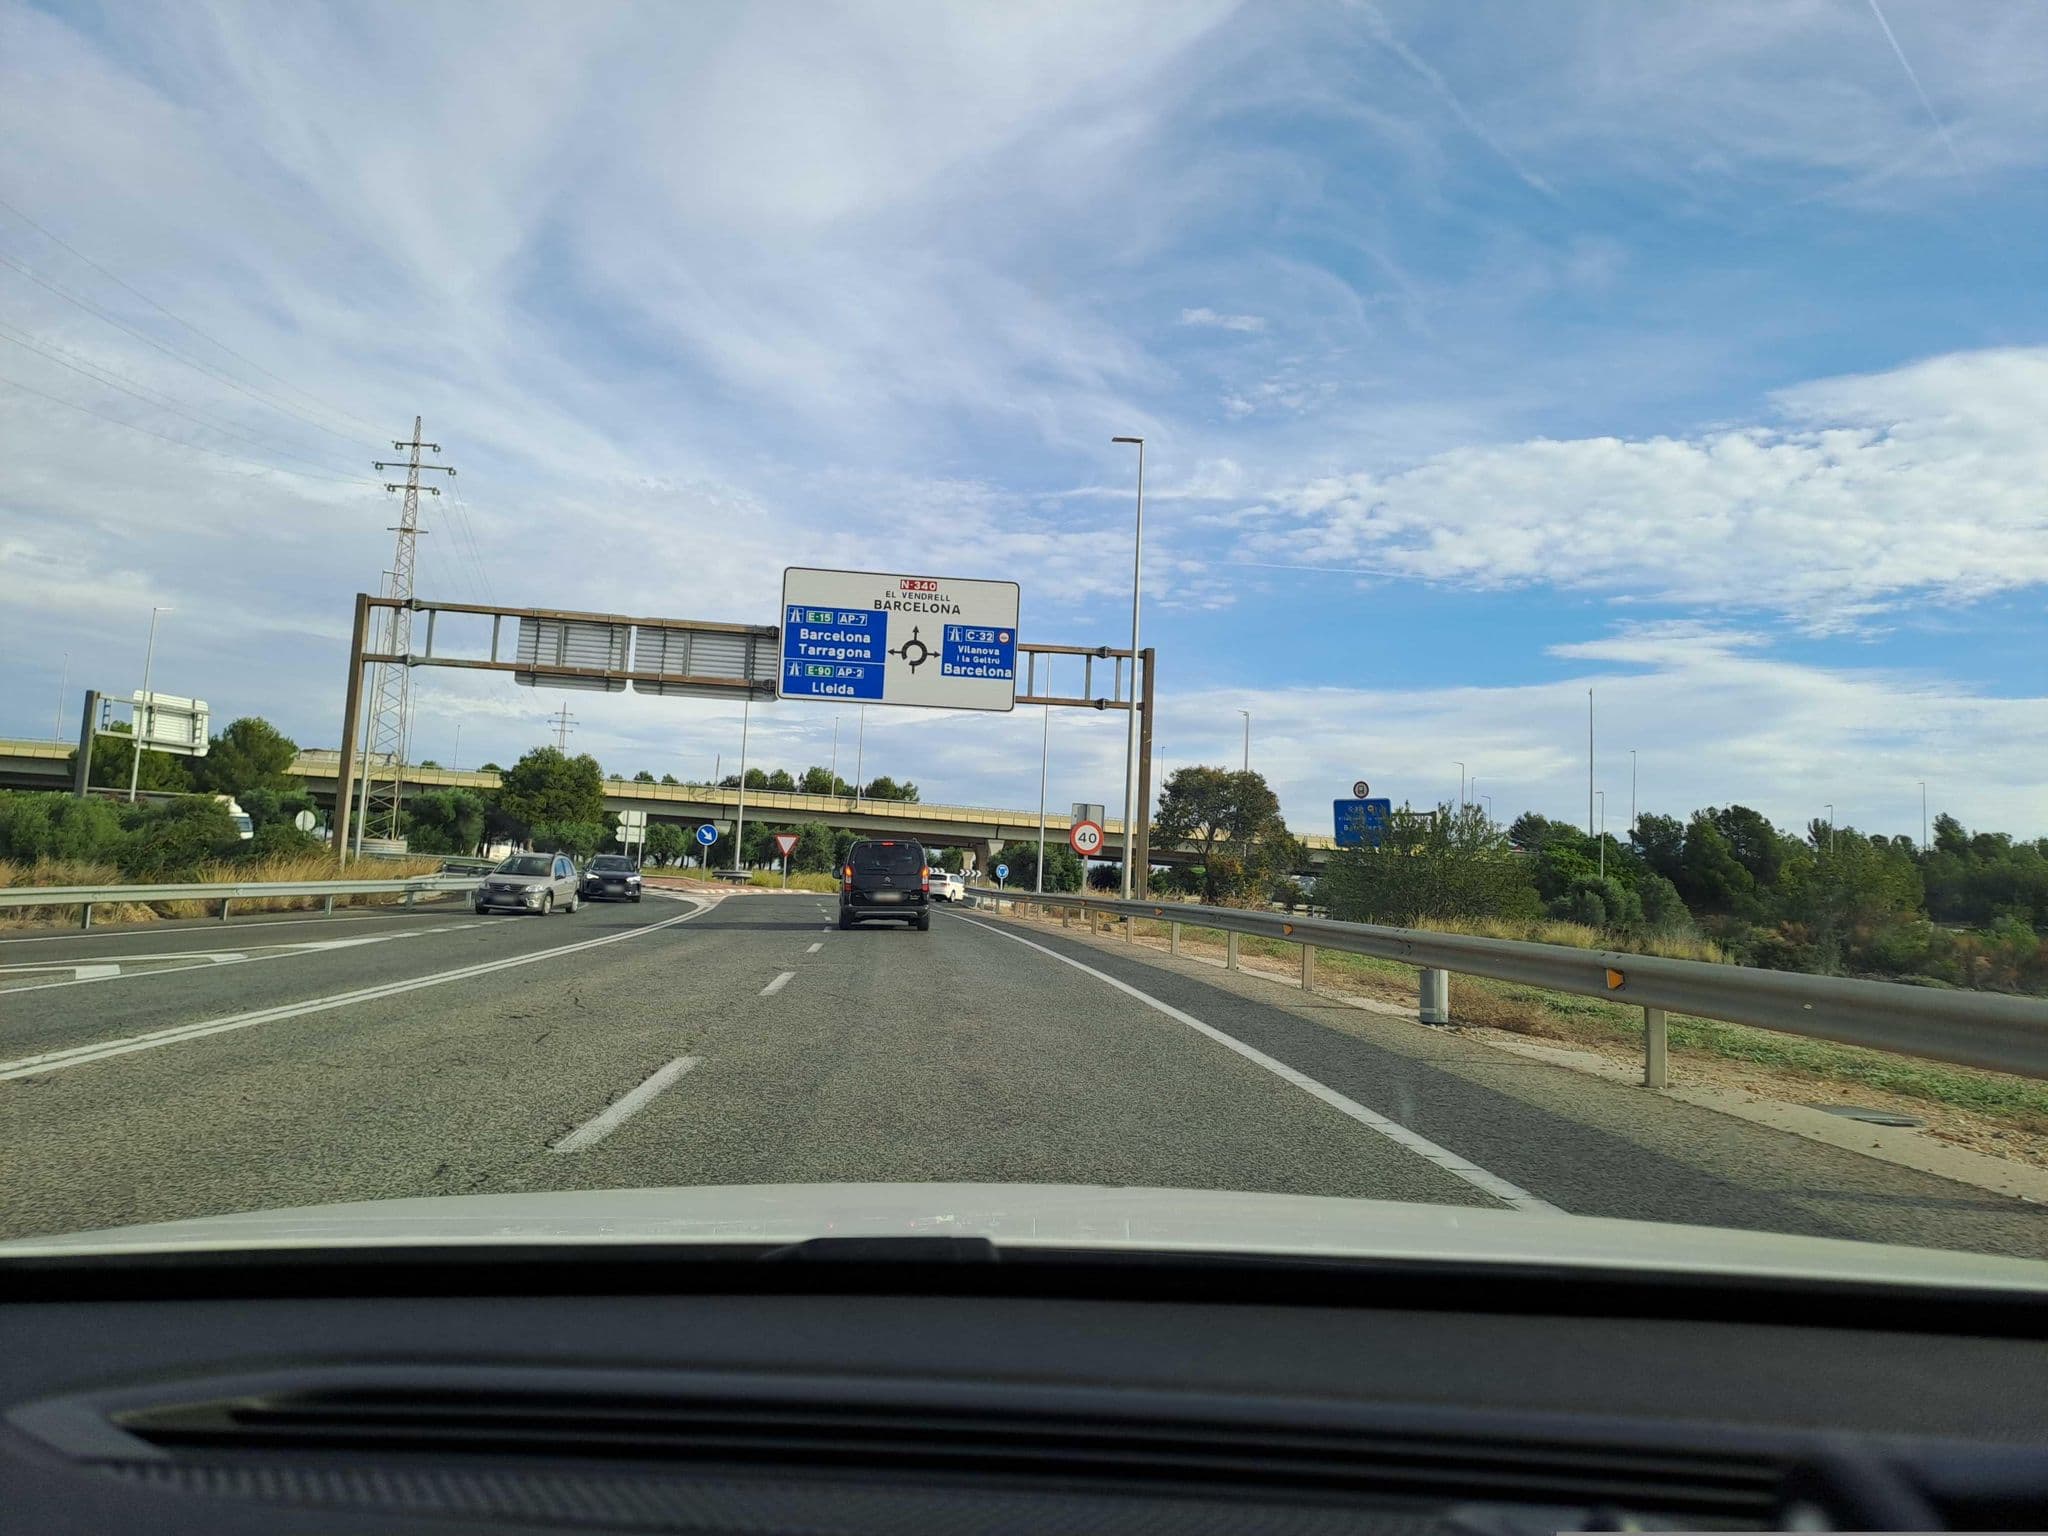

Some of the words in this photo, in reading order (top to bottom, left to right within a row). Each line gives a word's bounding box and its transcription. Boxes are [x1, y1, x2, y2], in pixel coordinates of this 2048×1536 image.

[901, 580, 936, 590] N-340
[885, 590, 896, 598] EL
[902, 592, 950, 601] VENDRELL
[874, 600, 960, 614] BARCELONA
[808, 611, 831, 622] E-15
[840, 614, 866, 624] AP-7
[800, 628, 871, 643] Barcelona
[967, 631, 993, 641] C-32
[799, 643, 871, 659] Tarragona
[958, 645, 1000, 656] Vilanova
[962, 655, 970, 663] la
[807, 666, 831, 676] E-90
[837, 668, 863, 678] AP-2
[943, 663, 1012, 677] Barcelona
[812, 682, 854, 695] Lleida
[1078, 832, 1097, 844] 40
